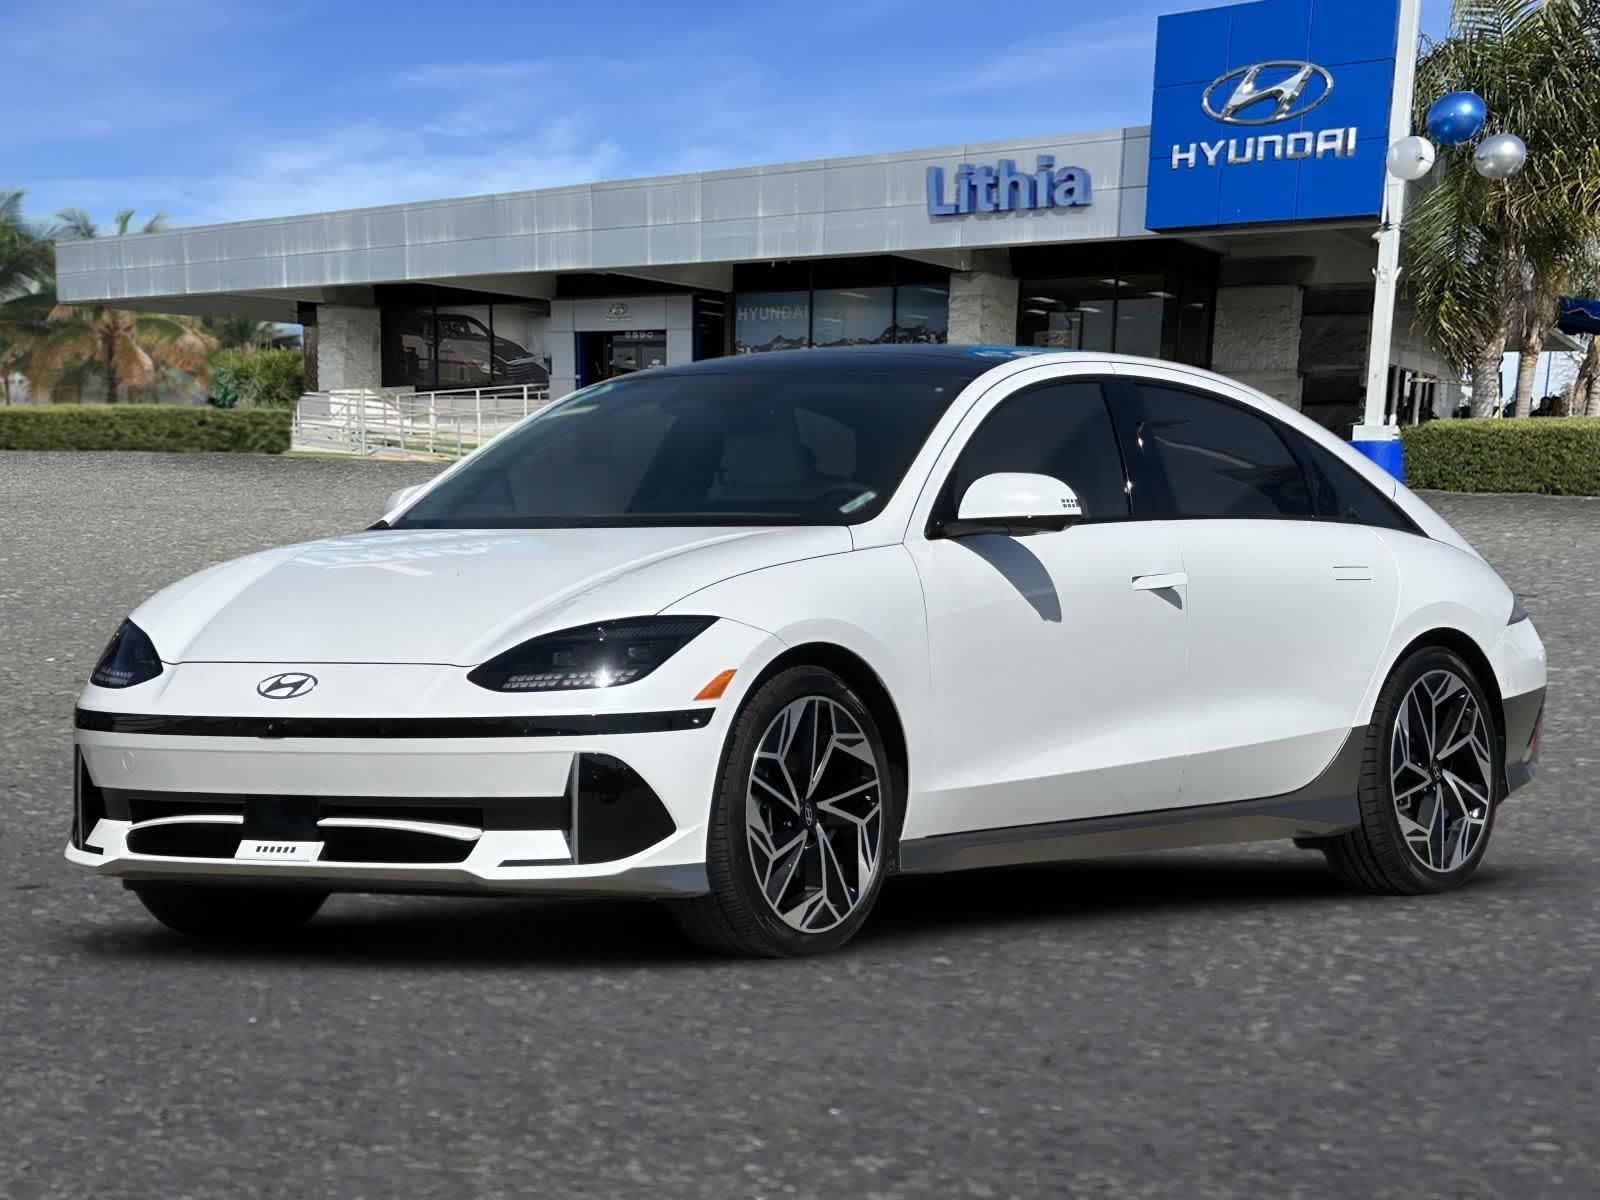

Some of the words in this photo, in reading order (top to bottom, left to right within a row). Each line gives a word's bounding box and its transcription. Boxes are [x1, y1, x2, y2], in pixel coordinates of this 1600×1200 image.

[1171, 127, 1357, 169] HYUNDAI
[926, 154, 1092, 217] Lithia
[736, 305, 809, 321] HYUNDAI
